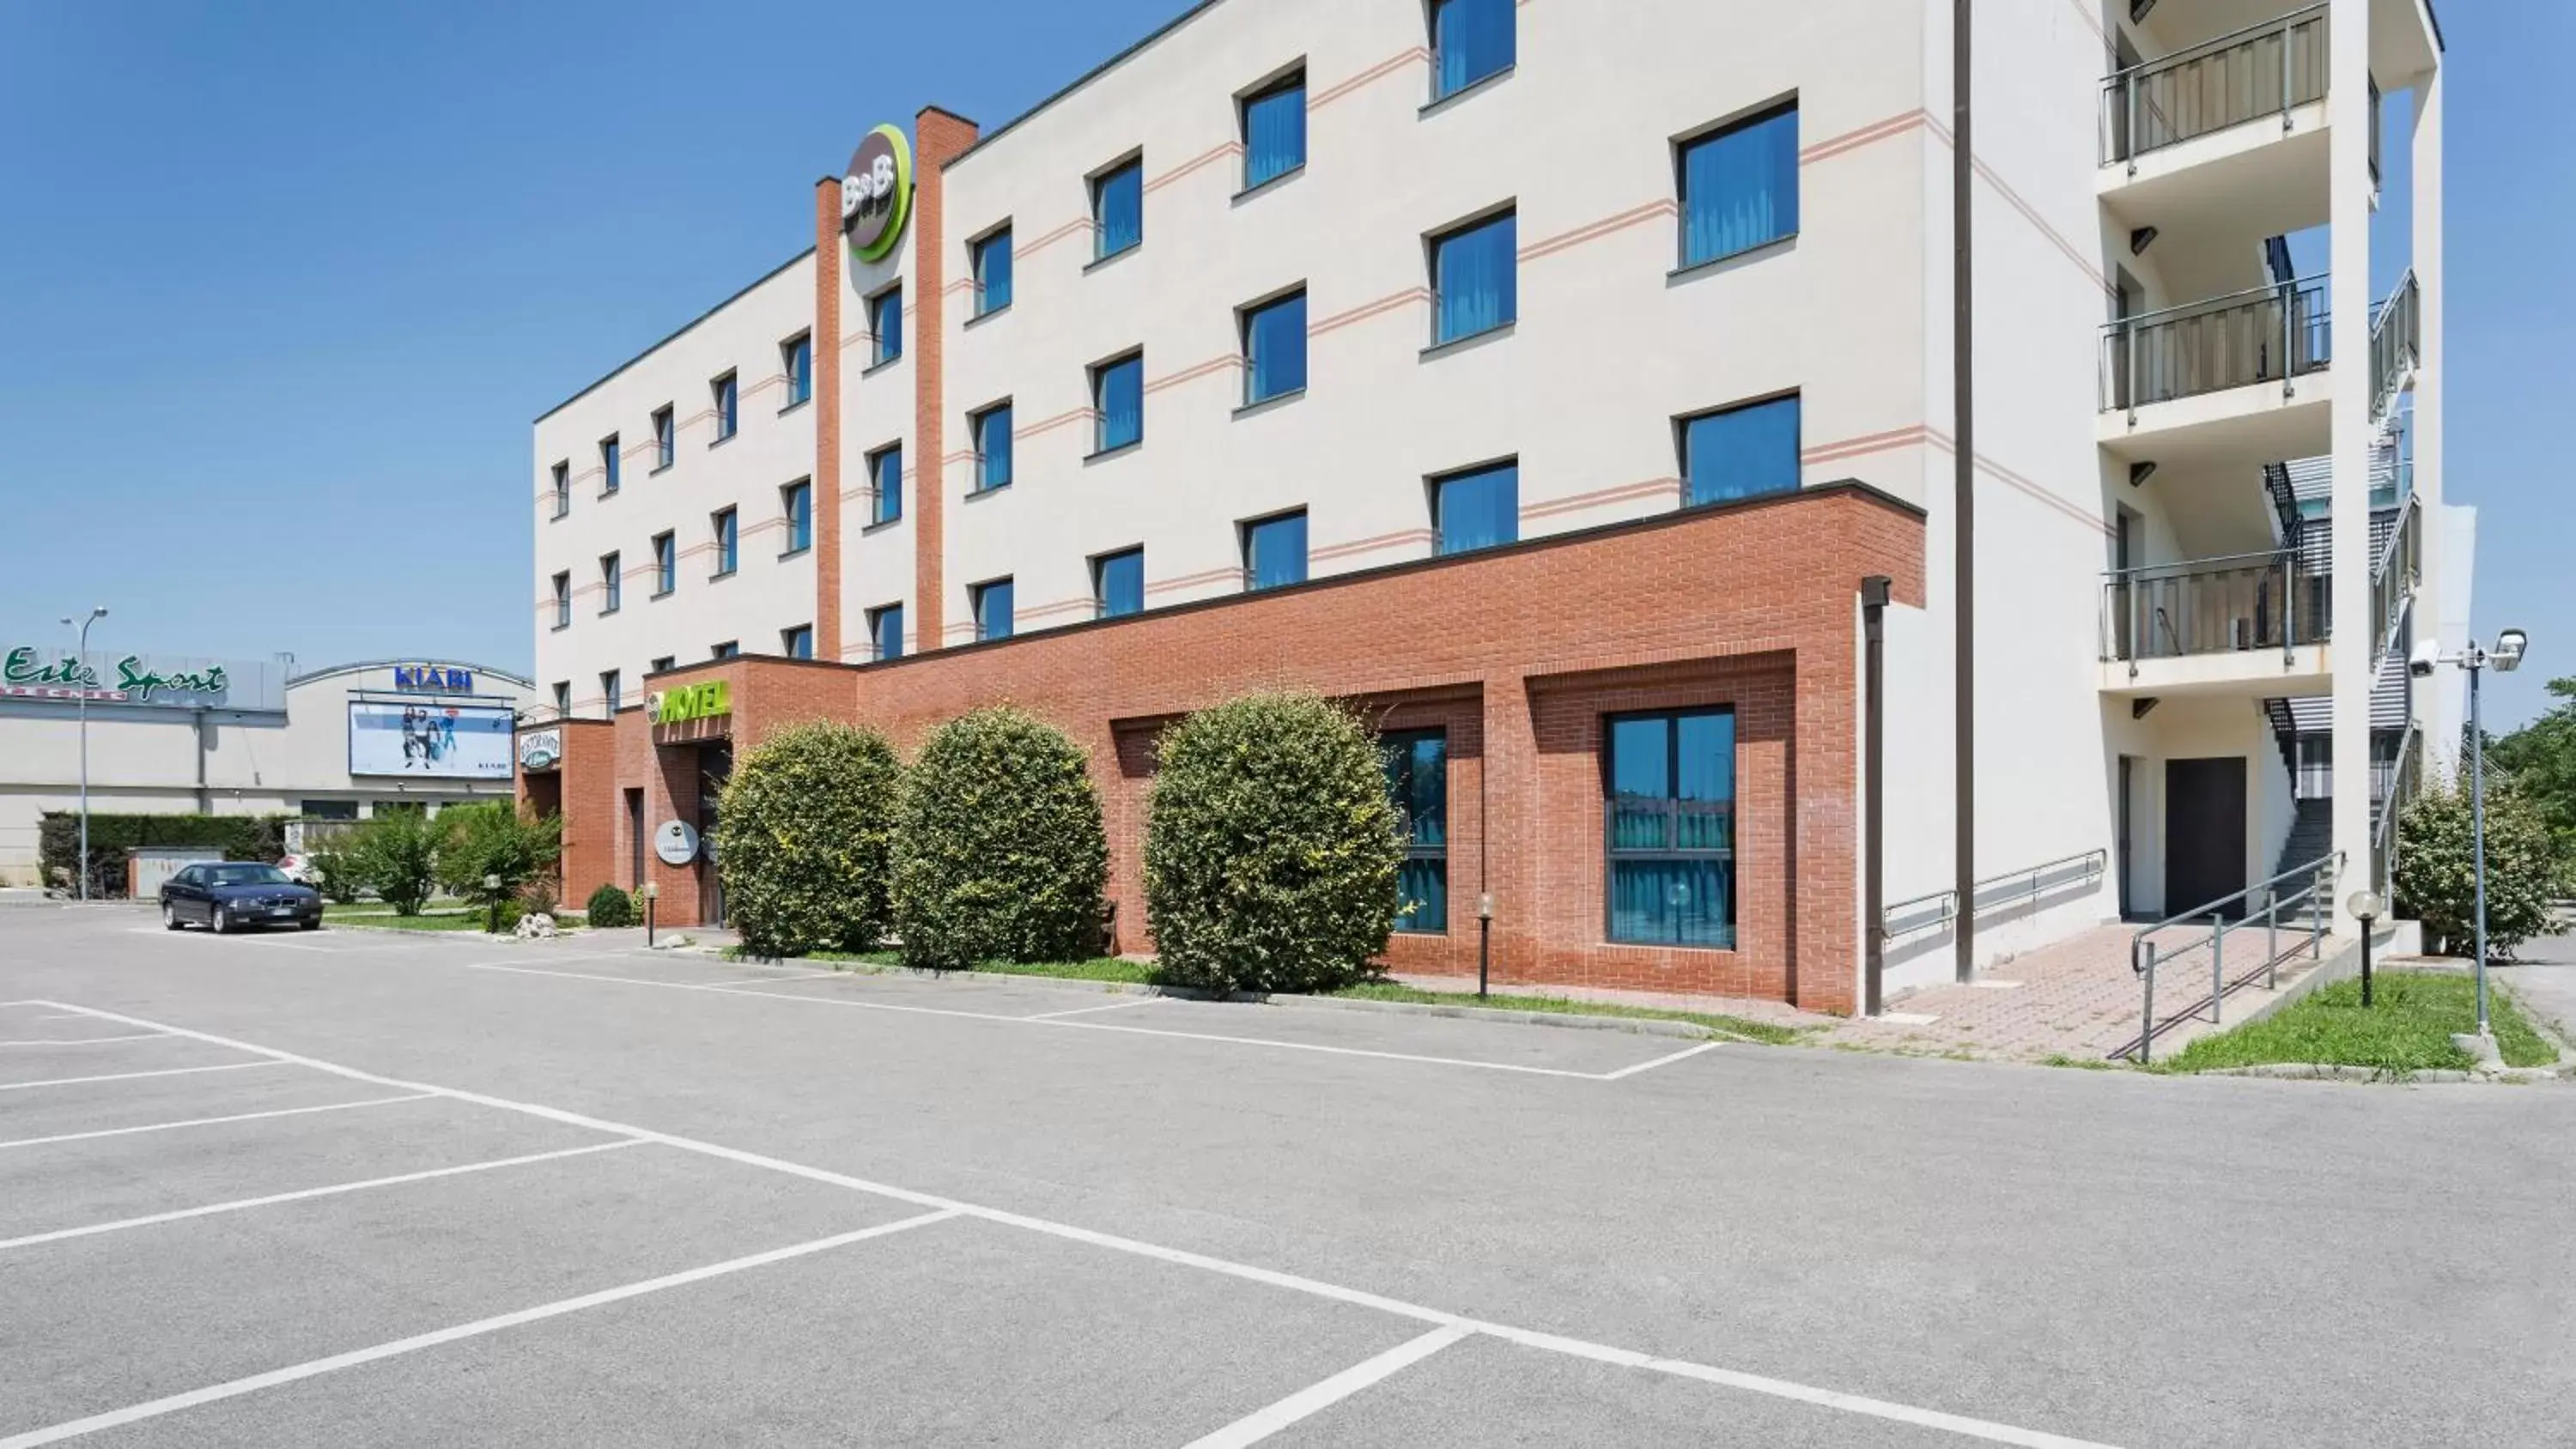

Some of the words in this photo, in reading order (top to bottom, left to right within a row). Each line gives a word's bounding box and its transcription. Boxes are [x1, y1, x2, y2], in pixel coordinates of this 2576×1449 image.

[4, 646, 100, 686] Este
[117, 655, 225, 700] Sport
[395, 666, 472, 688] KIABI
[659, 681, 729, 723] HOTEL
